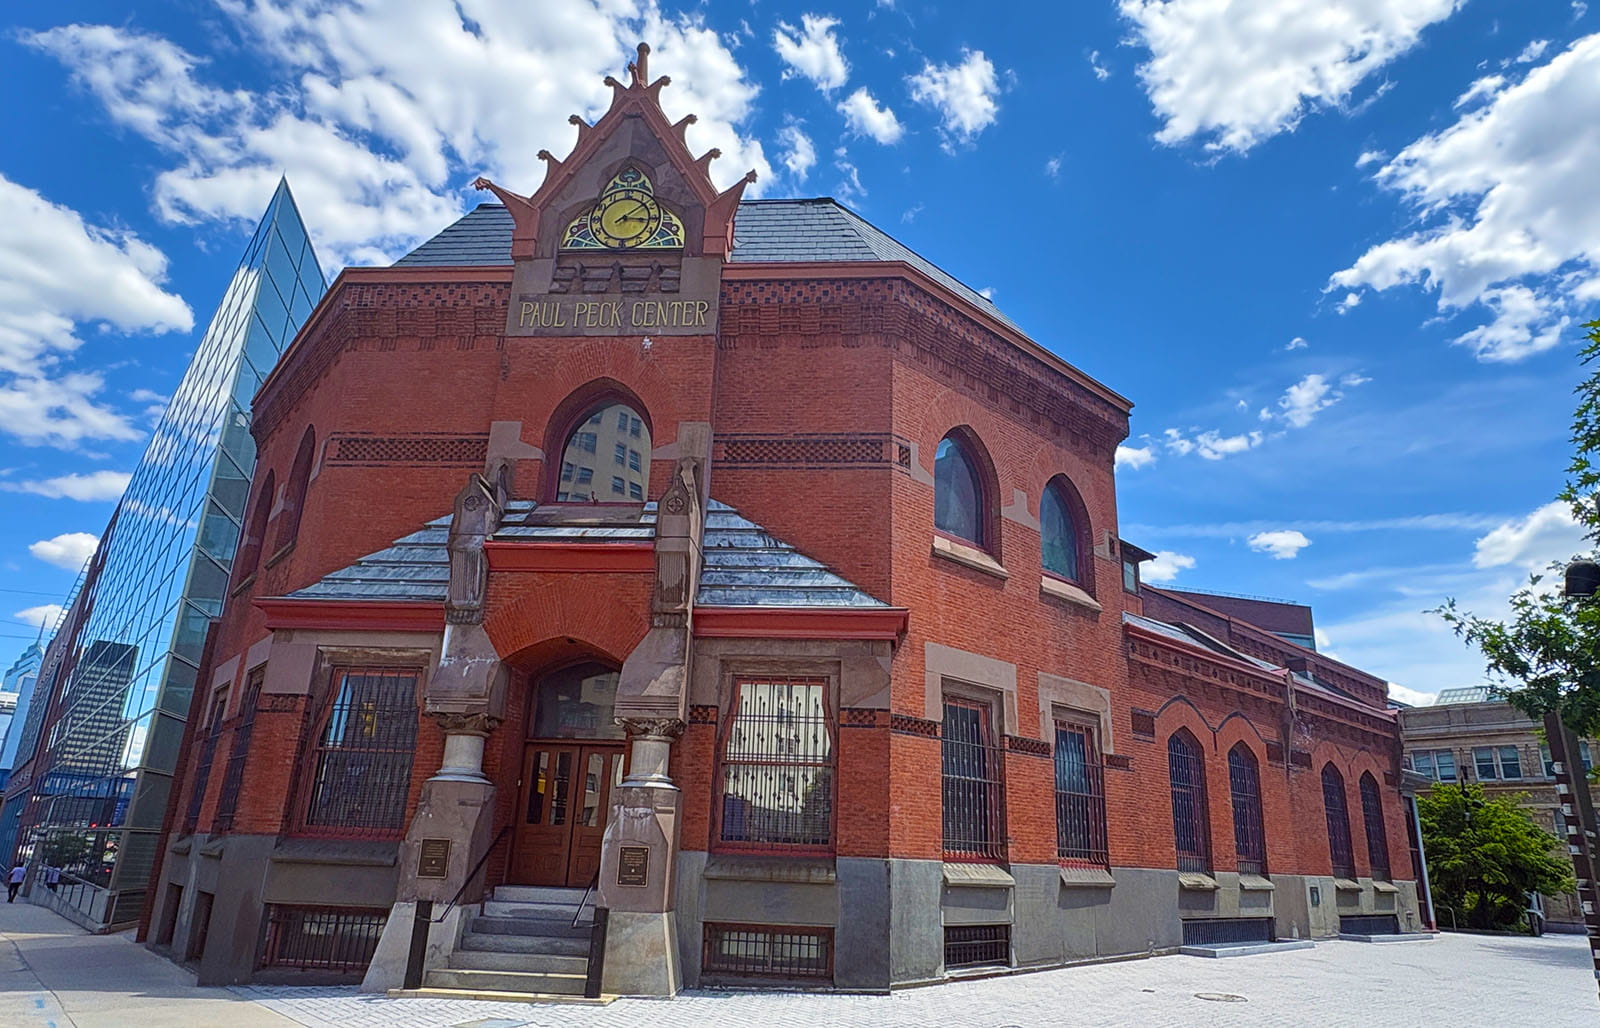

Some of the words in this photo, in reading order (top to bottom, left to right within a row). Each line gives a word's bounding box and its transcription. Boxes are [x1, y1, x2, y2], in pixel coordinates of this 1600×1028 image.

[519, 301, 566, 327] PAUL
[573, 302, 624, 327] PECK
[631, 301, 709, 326] CENTER
